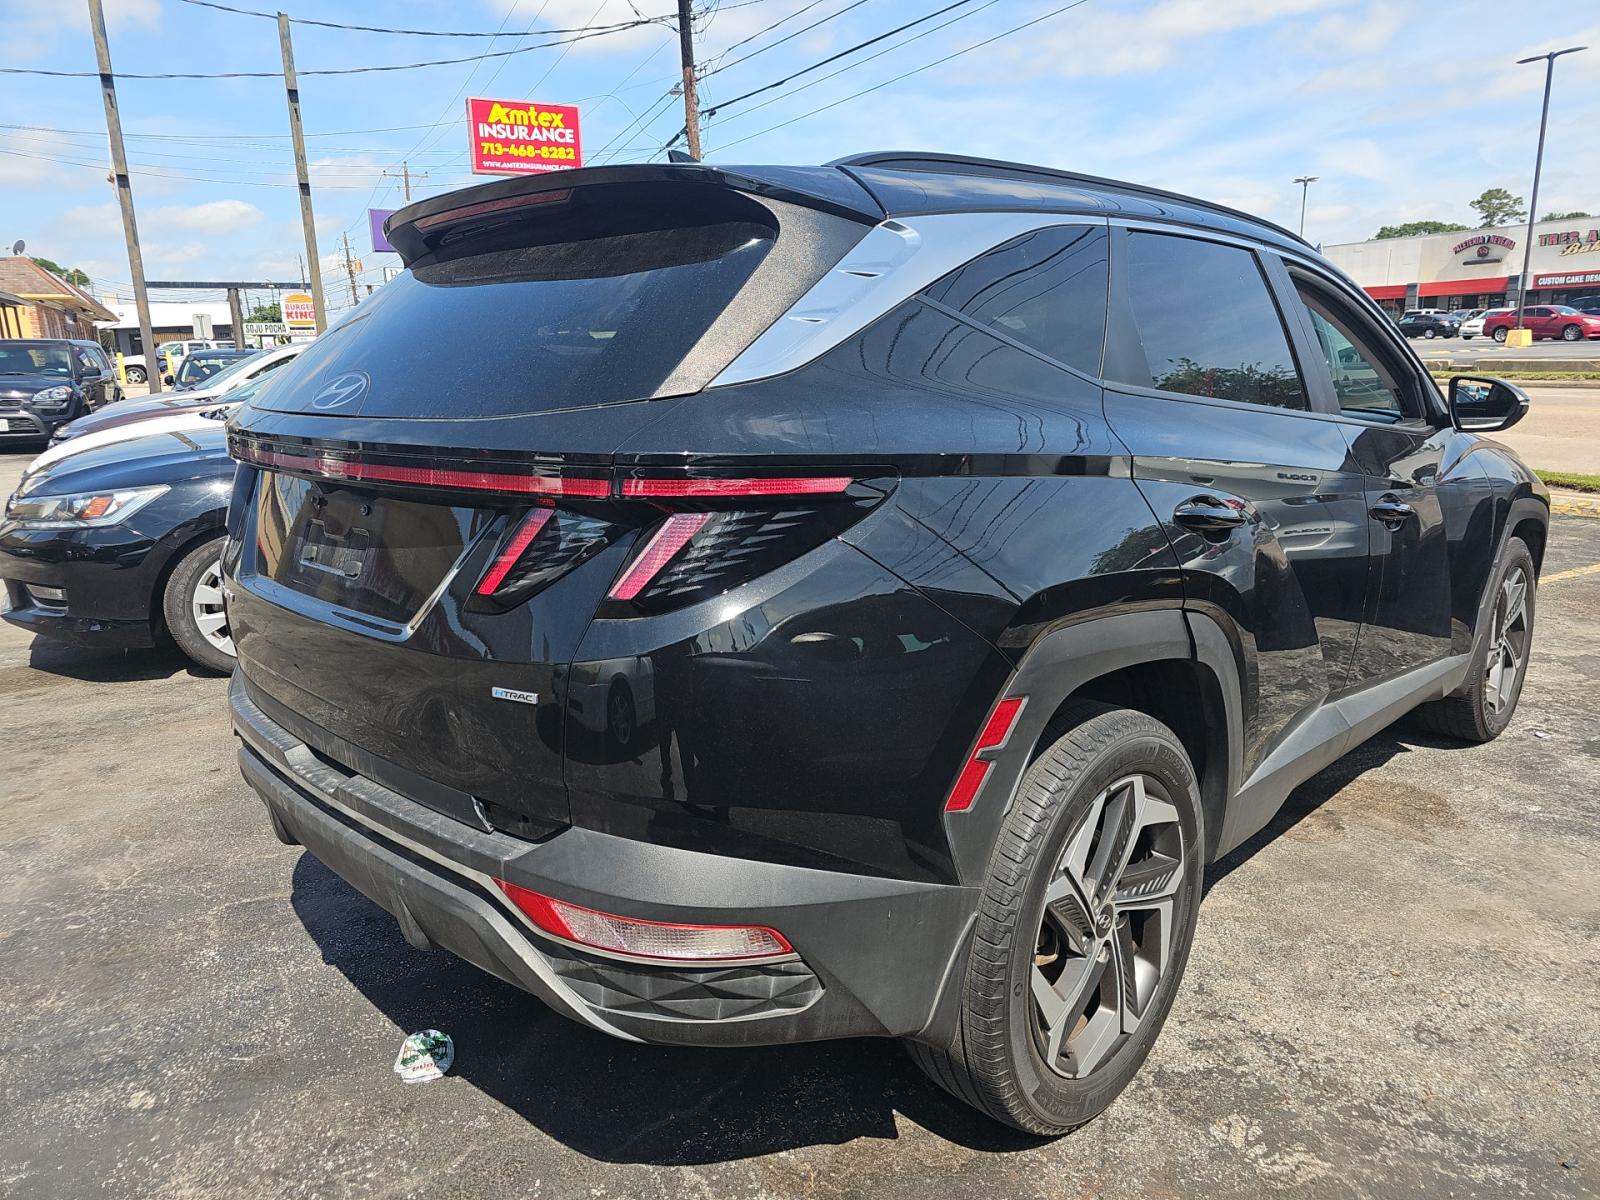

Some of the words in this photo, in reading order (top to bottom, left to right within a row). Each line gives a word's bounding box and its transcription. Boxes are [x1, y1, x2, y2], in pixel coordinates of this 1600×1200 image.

[487, 102, 565, 128] Amtex
[478, 122, 575, 143] INSURANCE
[480, 141, 576, 160] 713-468-8282
[1538, 231, 1580, 247] TRES
[1538, 276, 1566, 286] CUSTOM
[1566, 275, 1584, 284] CAKE
[286, 311, 315, 320] KING
[245, 324, 263, 333] SOJU
[265, 324, 287, 333] POCHA
[495, 689, 533, 702] HTRAC
